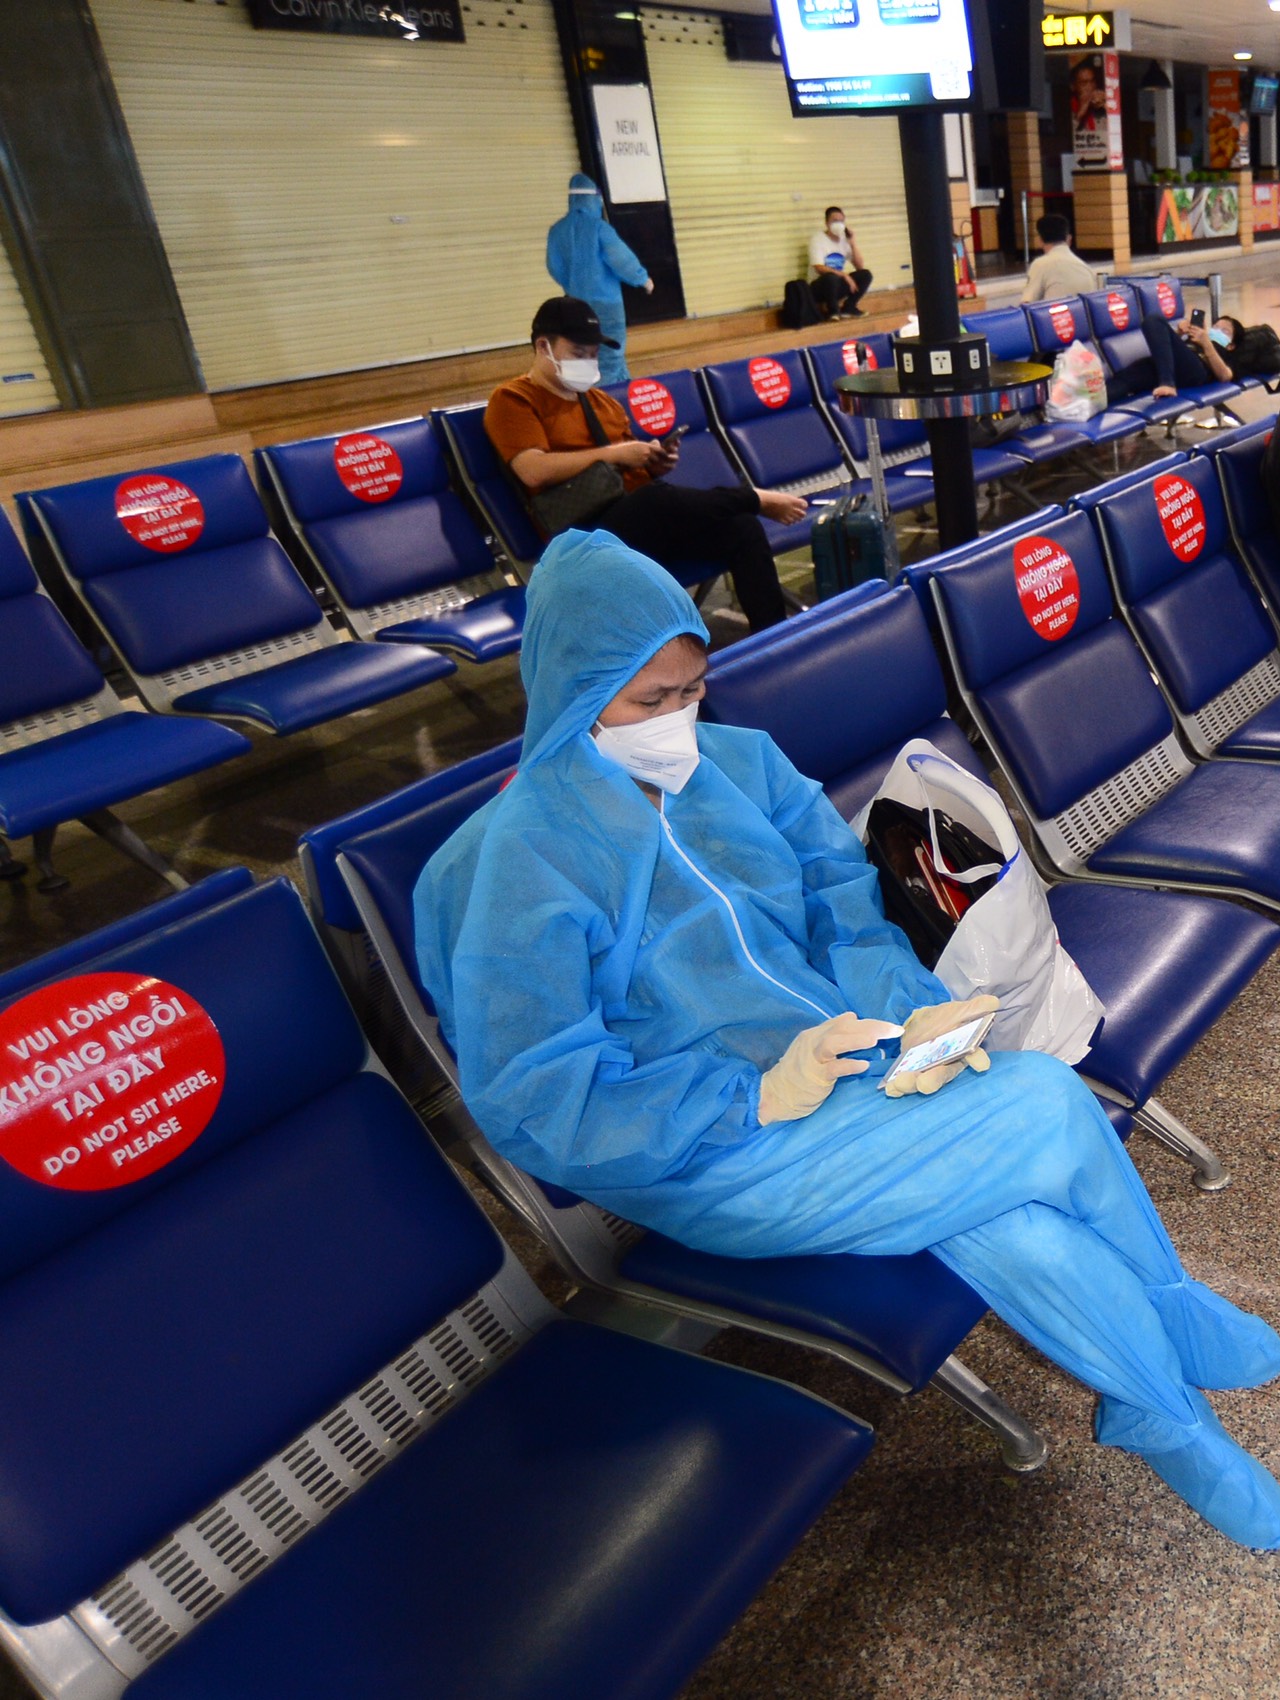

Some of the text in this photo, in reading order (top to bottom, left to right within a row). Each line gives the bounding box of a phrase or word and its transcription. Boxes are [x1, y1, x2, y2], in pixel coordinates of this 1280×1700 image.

[615, 120, 638, 134] NEW
[611, 141, 650, 156] ARRIVAL
[1020, 545, 1052, 568] VUI LÒNG
[1018, 566, 1048, 590] KHÔNG
[1034, 572, 1064, 603] TẠI ĐÂY
[1032, 613, 1042, 626] DO
[1041, 606, 1054, 620] NOT
[1048, 613, 1068, 631] PLEASE
[8, 992, 129, 1060] VUI LÒNG
[108, 995, 187, 1050] NGỒI
[52, 1046, 165, 1121] TẠI ĐÂY
[43, 1070, 217, 1176] DO NOT SIT HERE,
[112, 1117, 182, 1167] PLEASE
